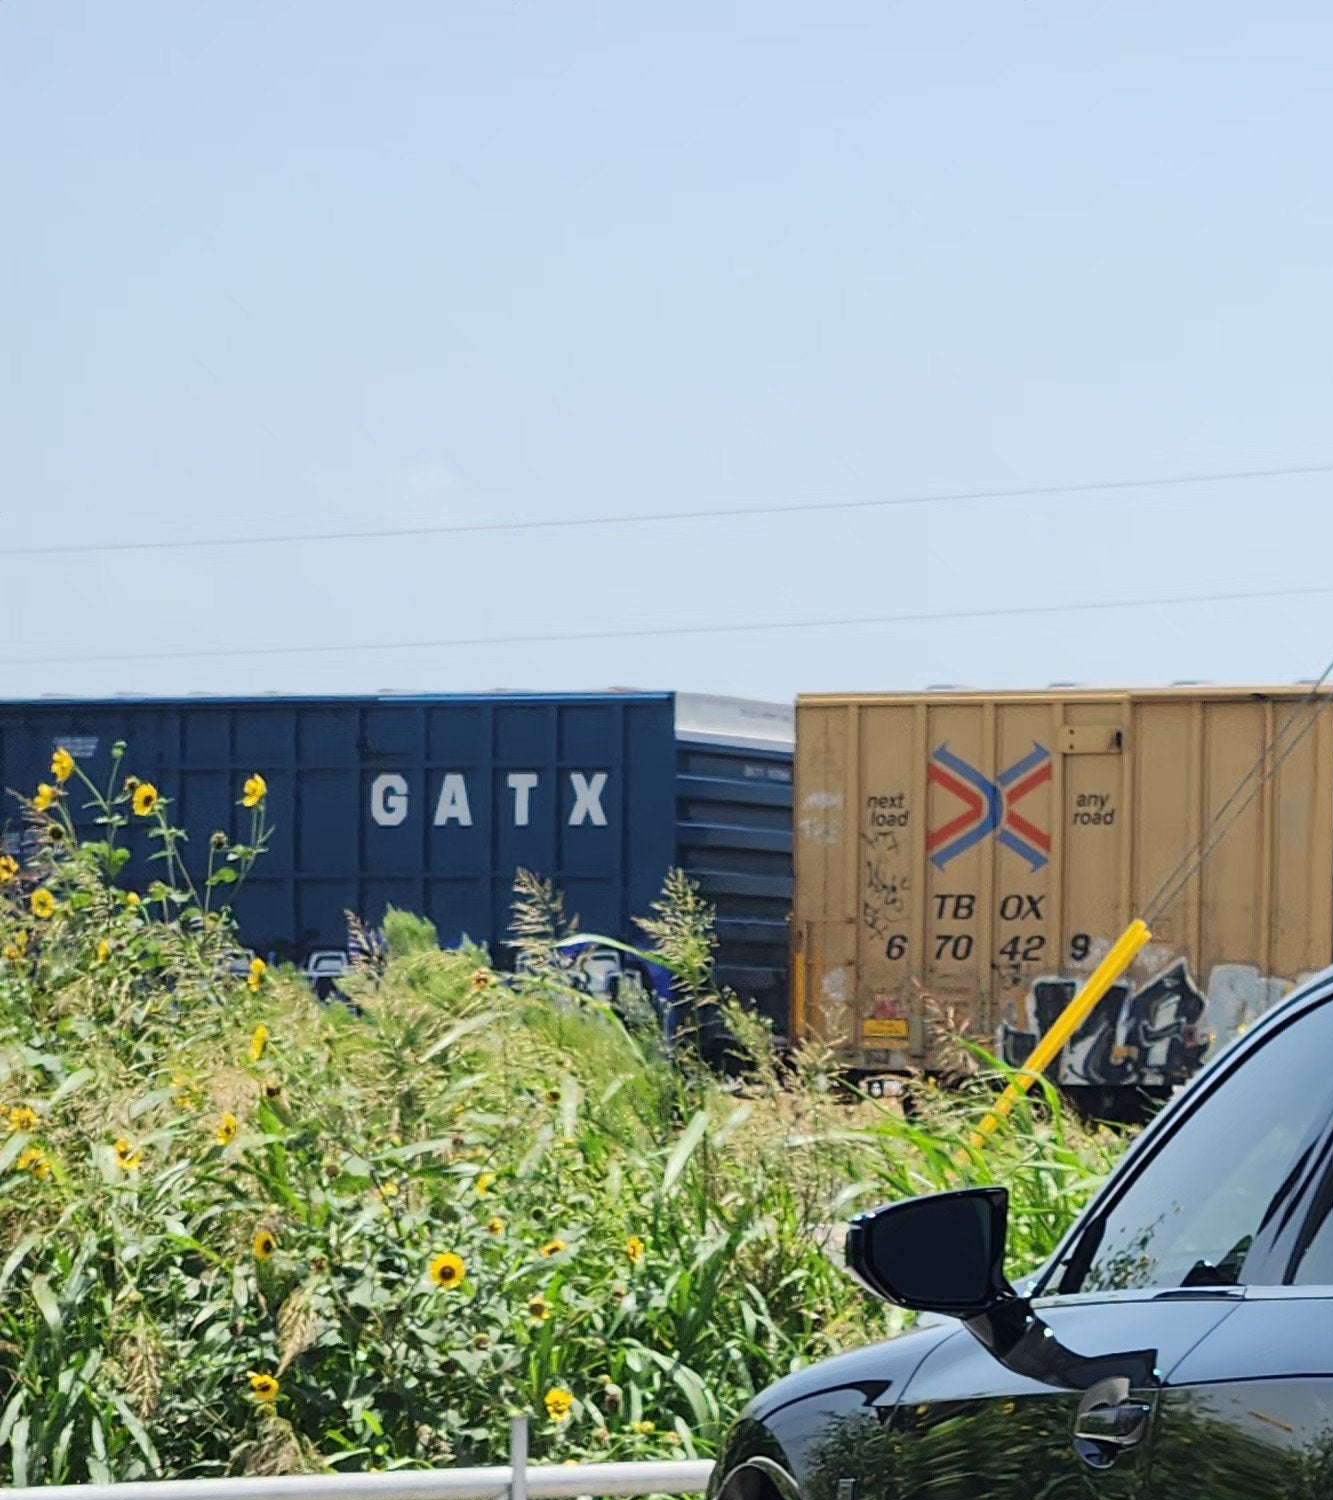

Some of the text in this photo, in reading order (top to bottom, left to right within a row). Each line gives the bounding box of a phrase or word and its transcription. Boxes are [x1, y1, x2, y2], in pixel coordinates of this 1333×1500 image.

[866, 793, 905, 809] next
[1075, 792, 1110, 812] any
[871, 809, 910, 827] load
[1072, 808, 1116, 826] road
